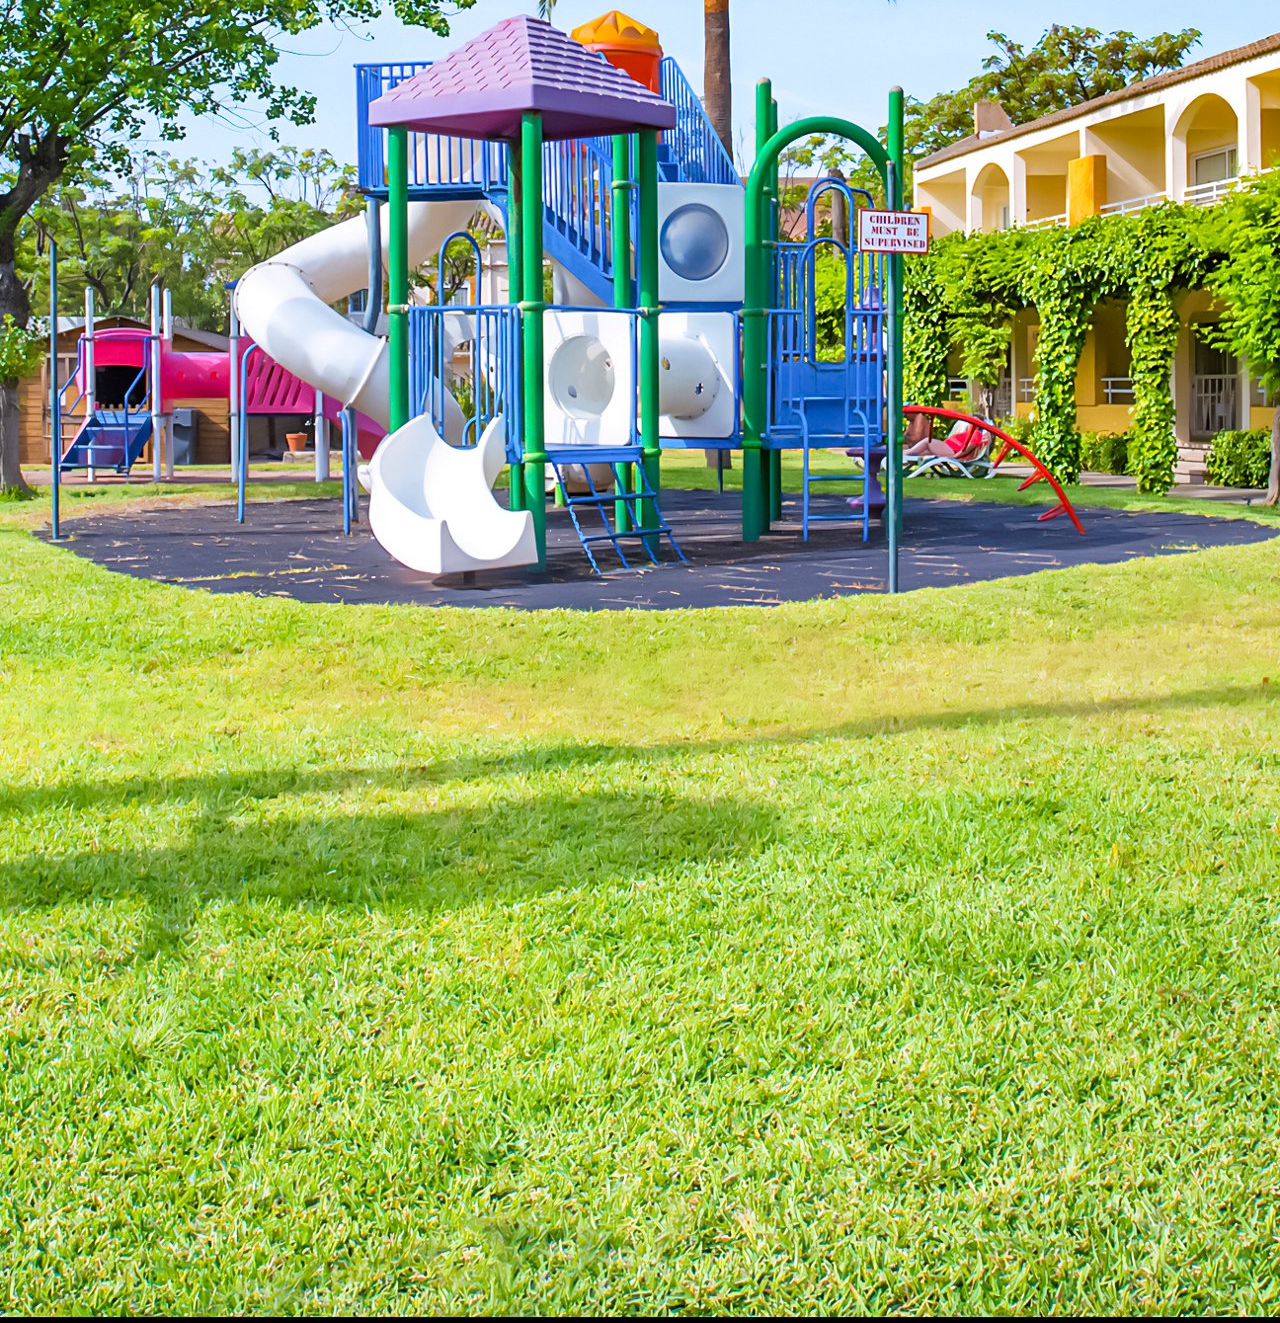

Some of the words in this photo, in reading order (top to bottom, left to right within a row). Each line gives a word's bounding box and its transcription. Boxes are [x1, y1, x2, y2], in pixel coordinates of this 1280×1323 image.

[869, 215, 921, 225] CHILDREN
[871, 226, 898, 236] MUST
[906, 227, 920, 237] BE
[864, 238, 926, 249] SUPERVISED
